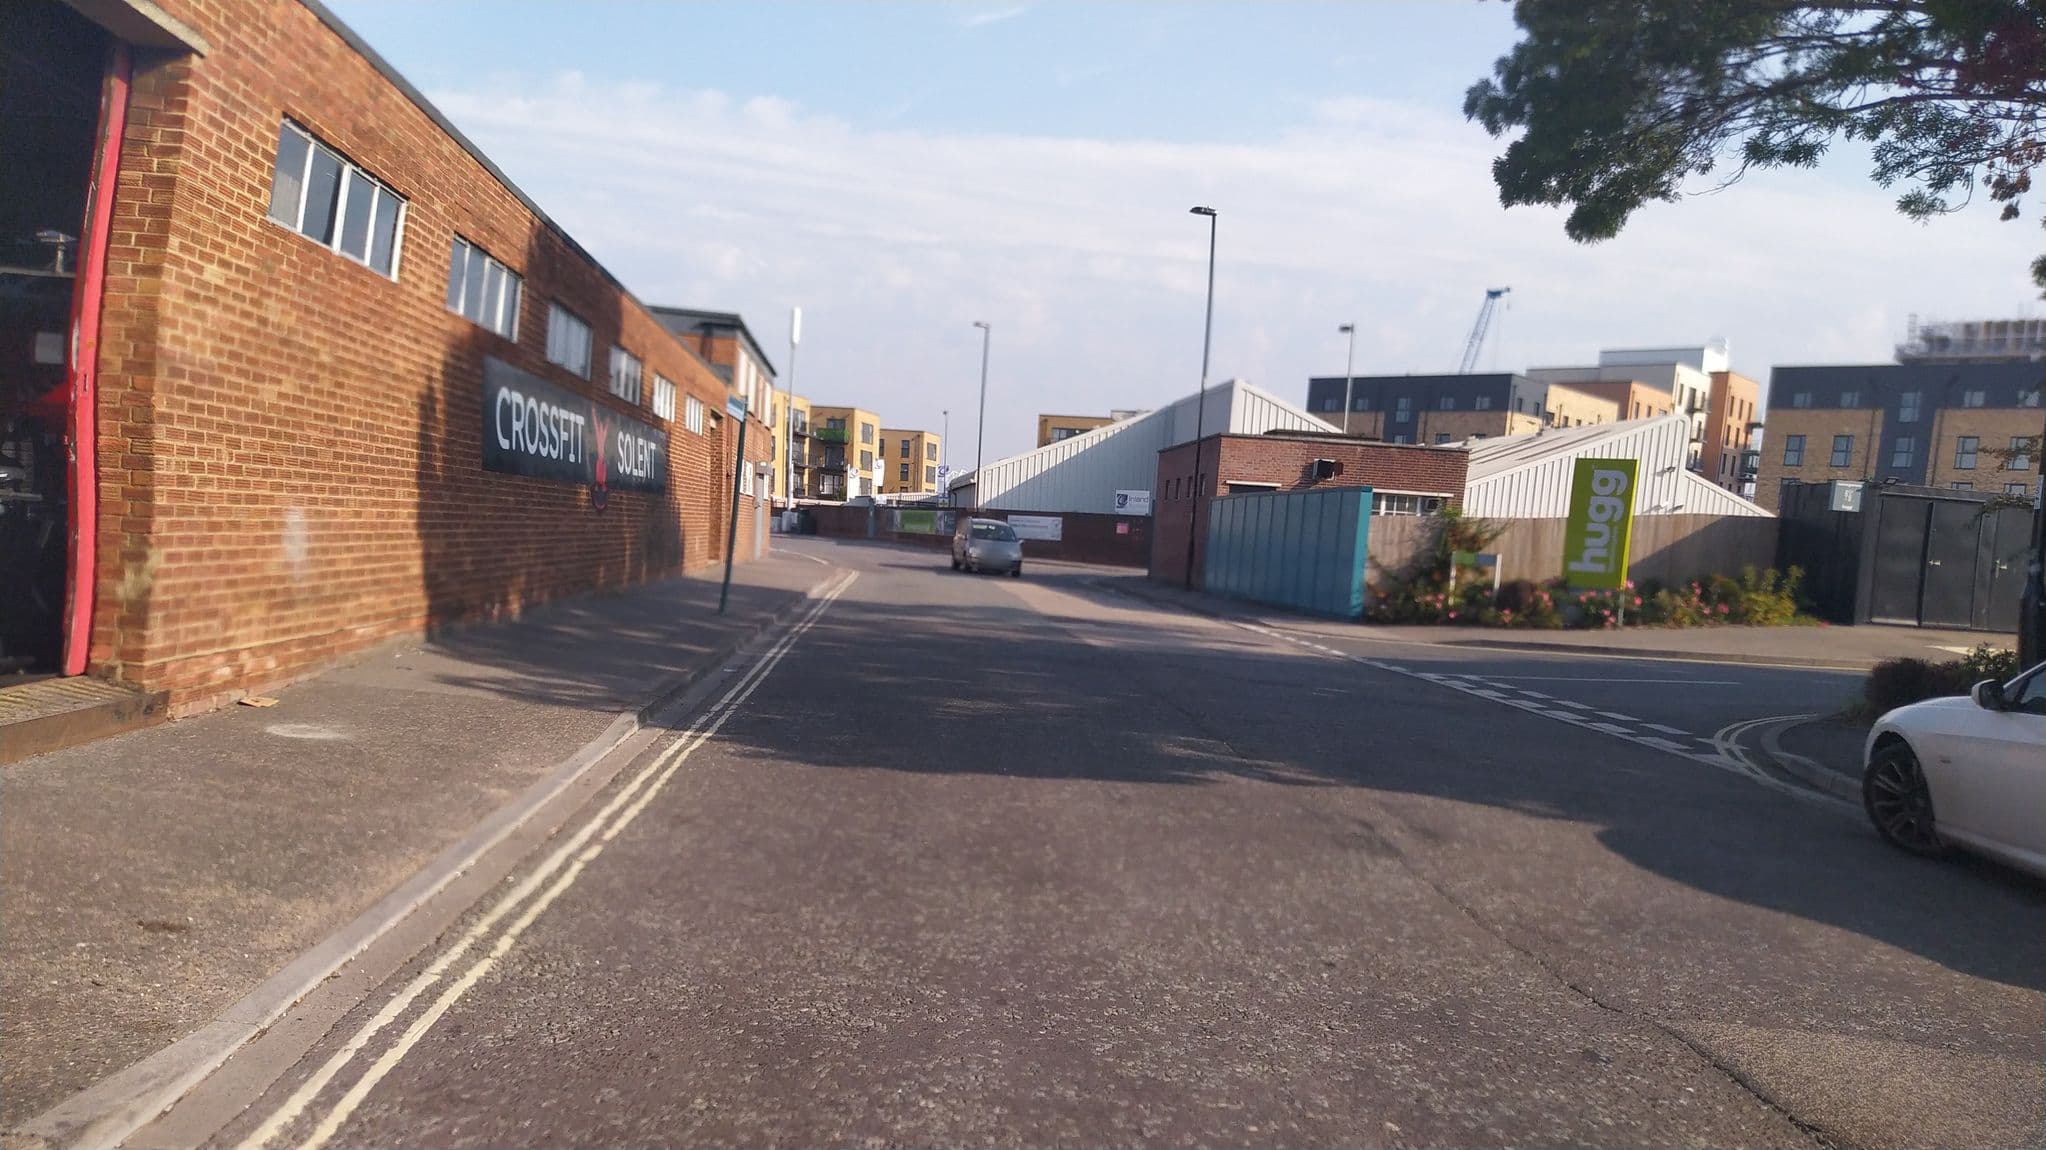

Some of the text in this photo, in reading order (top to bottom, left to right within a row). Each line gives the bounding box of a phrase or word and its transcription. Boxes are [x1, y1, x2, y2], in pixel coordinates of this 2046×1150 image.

[496, 386, 656, 479] CROSSFIT SOLENT
[1568, 469, 1628, 572] hugg
